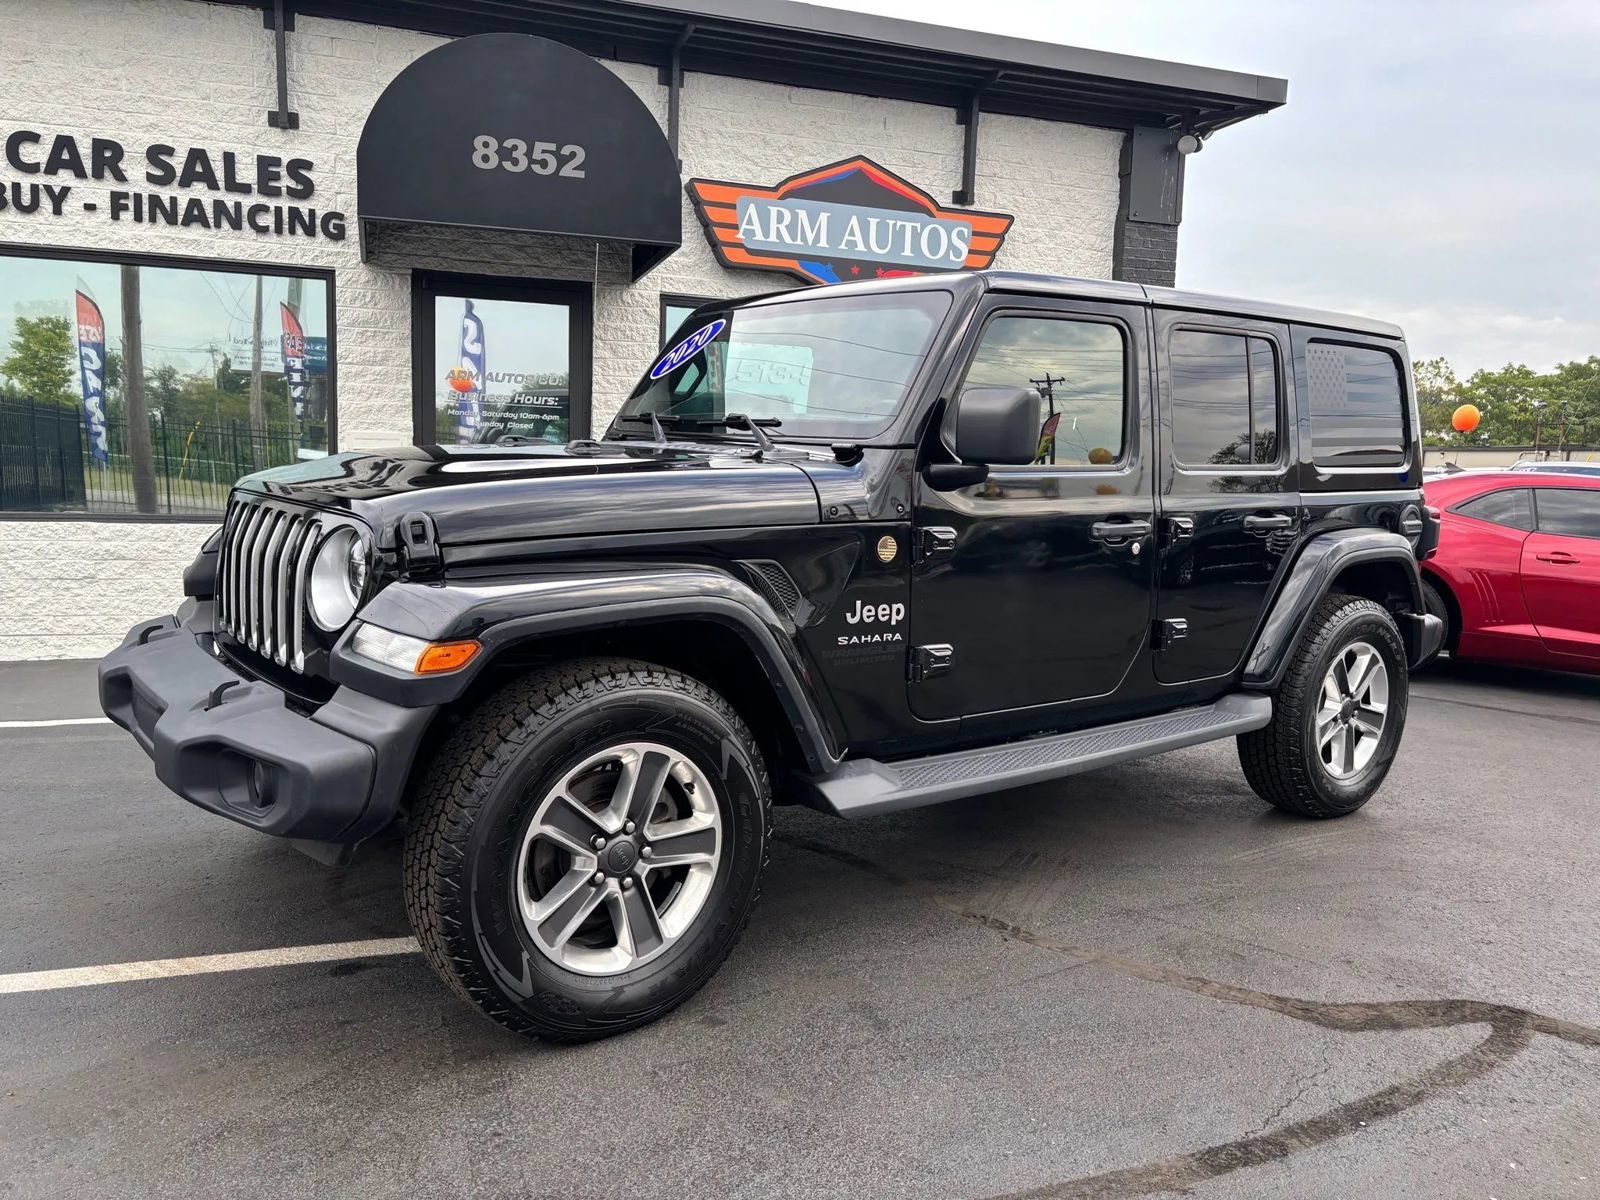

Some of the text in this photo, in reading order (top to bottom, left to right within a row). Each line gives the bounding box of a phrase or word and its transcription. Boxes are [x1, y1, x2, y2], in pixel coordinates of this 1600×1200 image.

[6, 130, 316, 200] CAR SALES
[472, 134, 586, 179] 8352
[110, 190, 346, 241] FINANCING
[736, 203, 970, 262] ARM AUTOS
[659, 325, 713, 375] 2020
[485, 371, 534, 385] AUTOS
[514, 393, 559, 406] Hours:
[507, 420, 534, 429] Closed
[519, 412, 560, 421] 10am-6pm
[846, 600, 905, 626] Jeep
[838, 632, 903, 645] SAHARA
